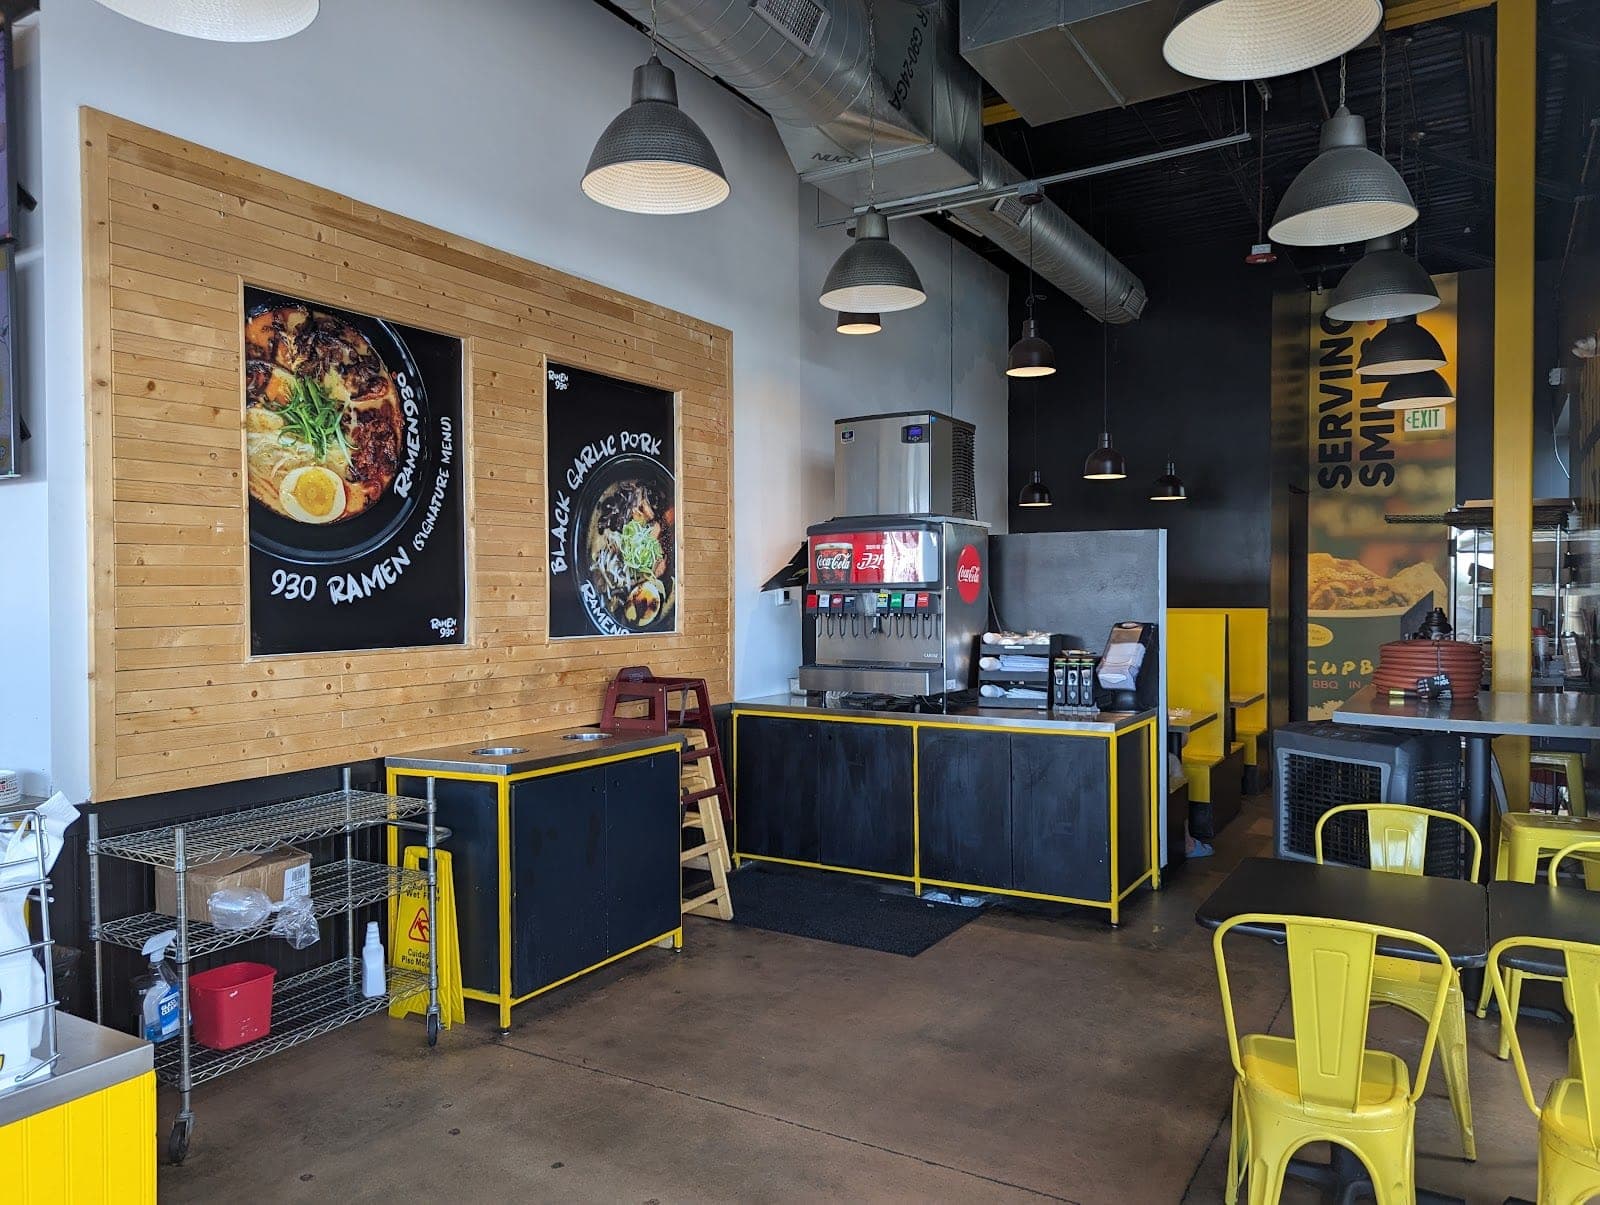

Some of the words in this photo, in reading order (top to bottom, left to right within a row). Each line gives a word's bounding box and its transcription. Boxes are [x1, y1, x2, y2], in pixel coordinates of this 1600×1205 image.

[547, 369, 569, 382] RAMEN
[554, 380, 569, 391] 930
[1411, 408, 1440, 429] EXIT
[551, 491, 570, 575] BLACK
[566, 435, 616, 490] GARLIC
[619, 431, 662, 456] PORK
[271, 569, 317, 601] 930
[327, 546, 411, 605] RAMEN
[412, 468, 450, 551] (SIGNATURE
[442, 416, 452, 465] MENU)
[430, 617, 457, 631] RAMEN
[439, 627, 456, 639] 930
[1312, 679, 1338, 690] BBQ
[1349, 679, 1361, 690] IN
[407, 948, 429, 960] Cuidad
